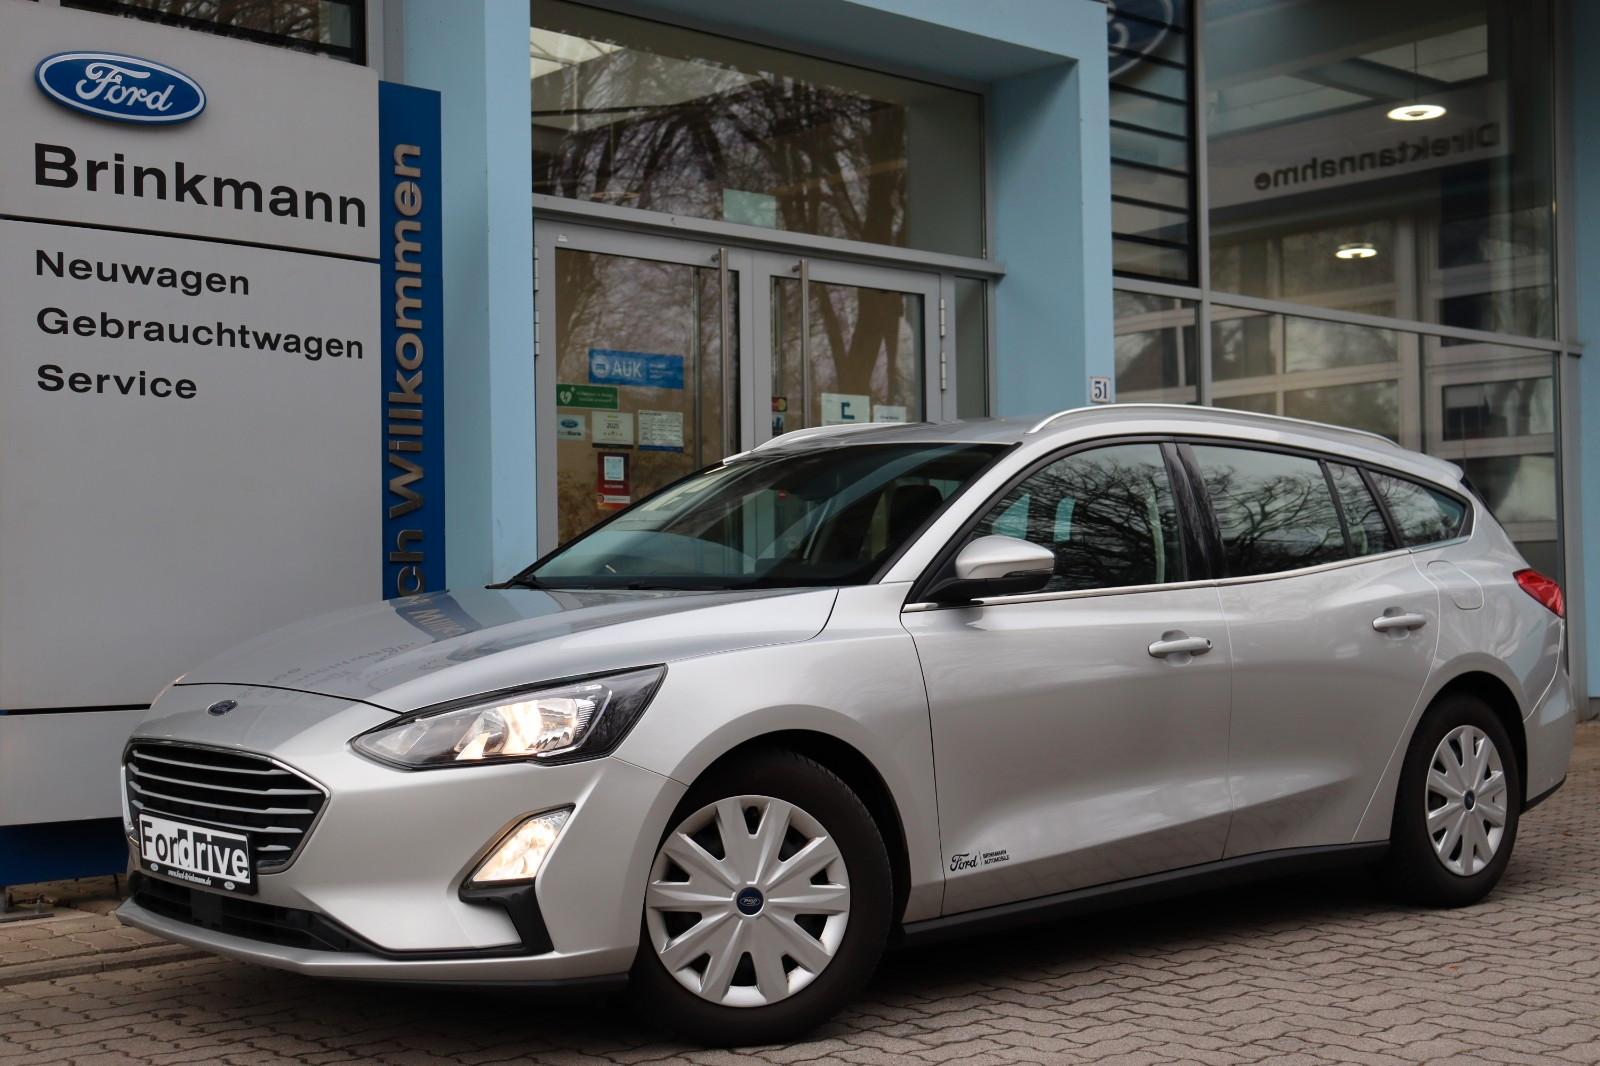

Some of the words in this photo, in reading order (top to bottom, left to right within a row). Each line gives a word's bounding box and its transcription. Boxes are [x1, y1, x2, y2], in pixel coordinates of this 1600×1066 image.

[75, 62, 175, 112] Ford
[34, 142, 366, 228] Brinkmann
[36, 249, 249, 296] Neuwagen
[36, 307, 363, 361] Gebrauchtwagen
[388, 143, 424, 520] Willkommen
[37, 364, 197, 399] Service
[1094, 380, 1107, 399] 51
[141, 820, 250, 879] Fordrive
[949, 852, 978, 871] Ford
